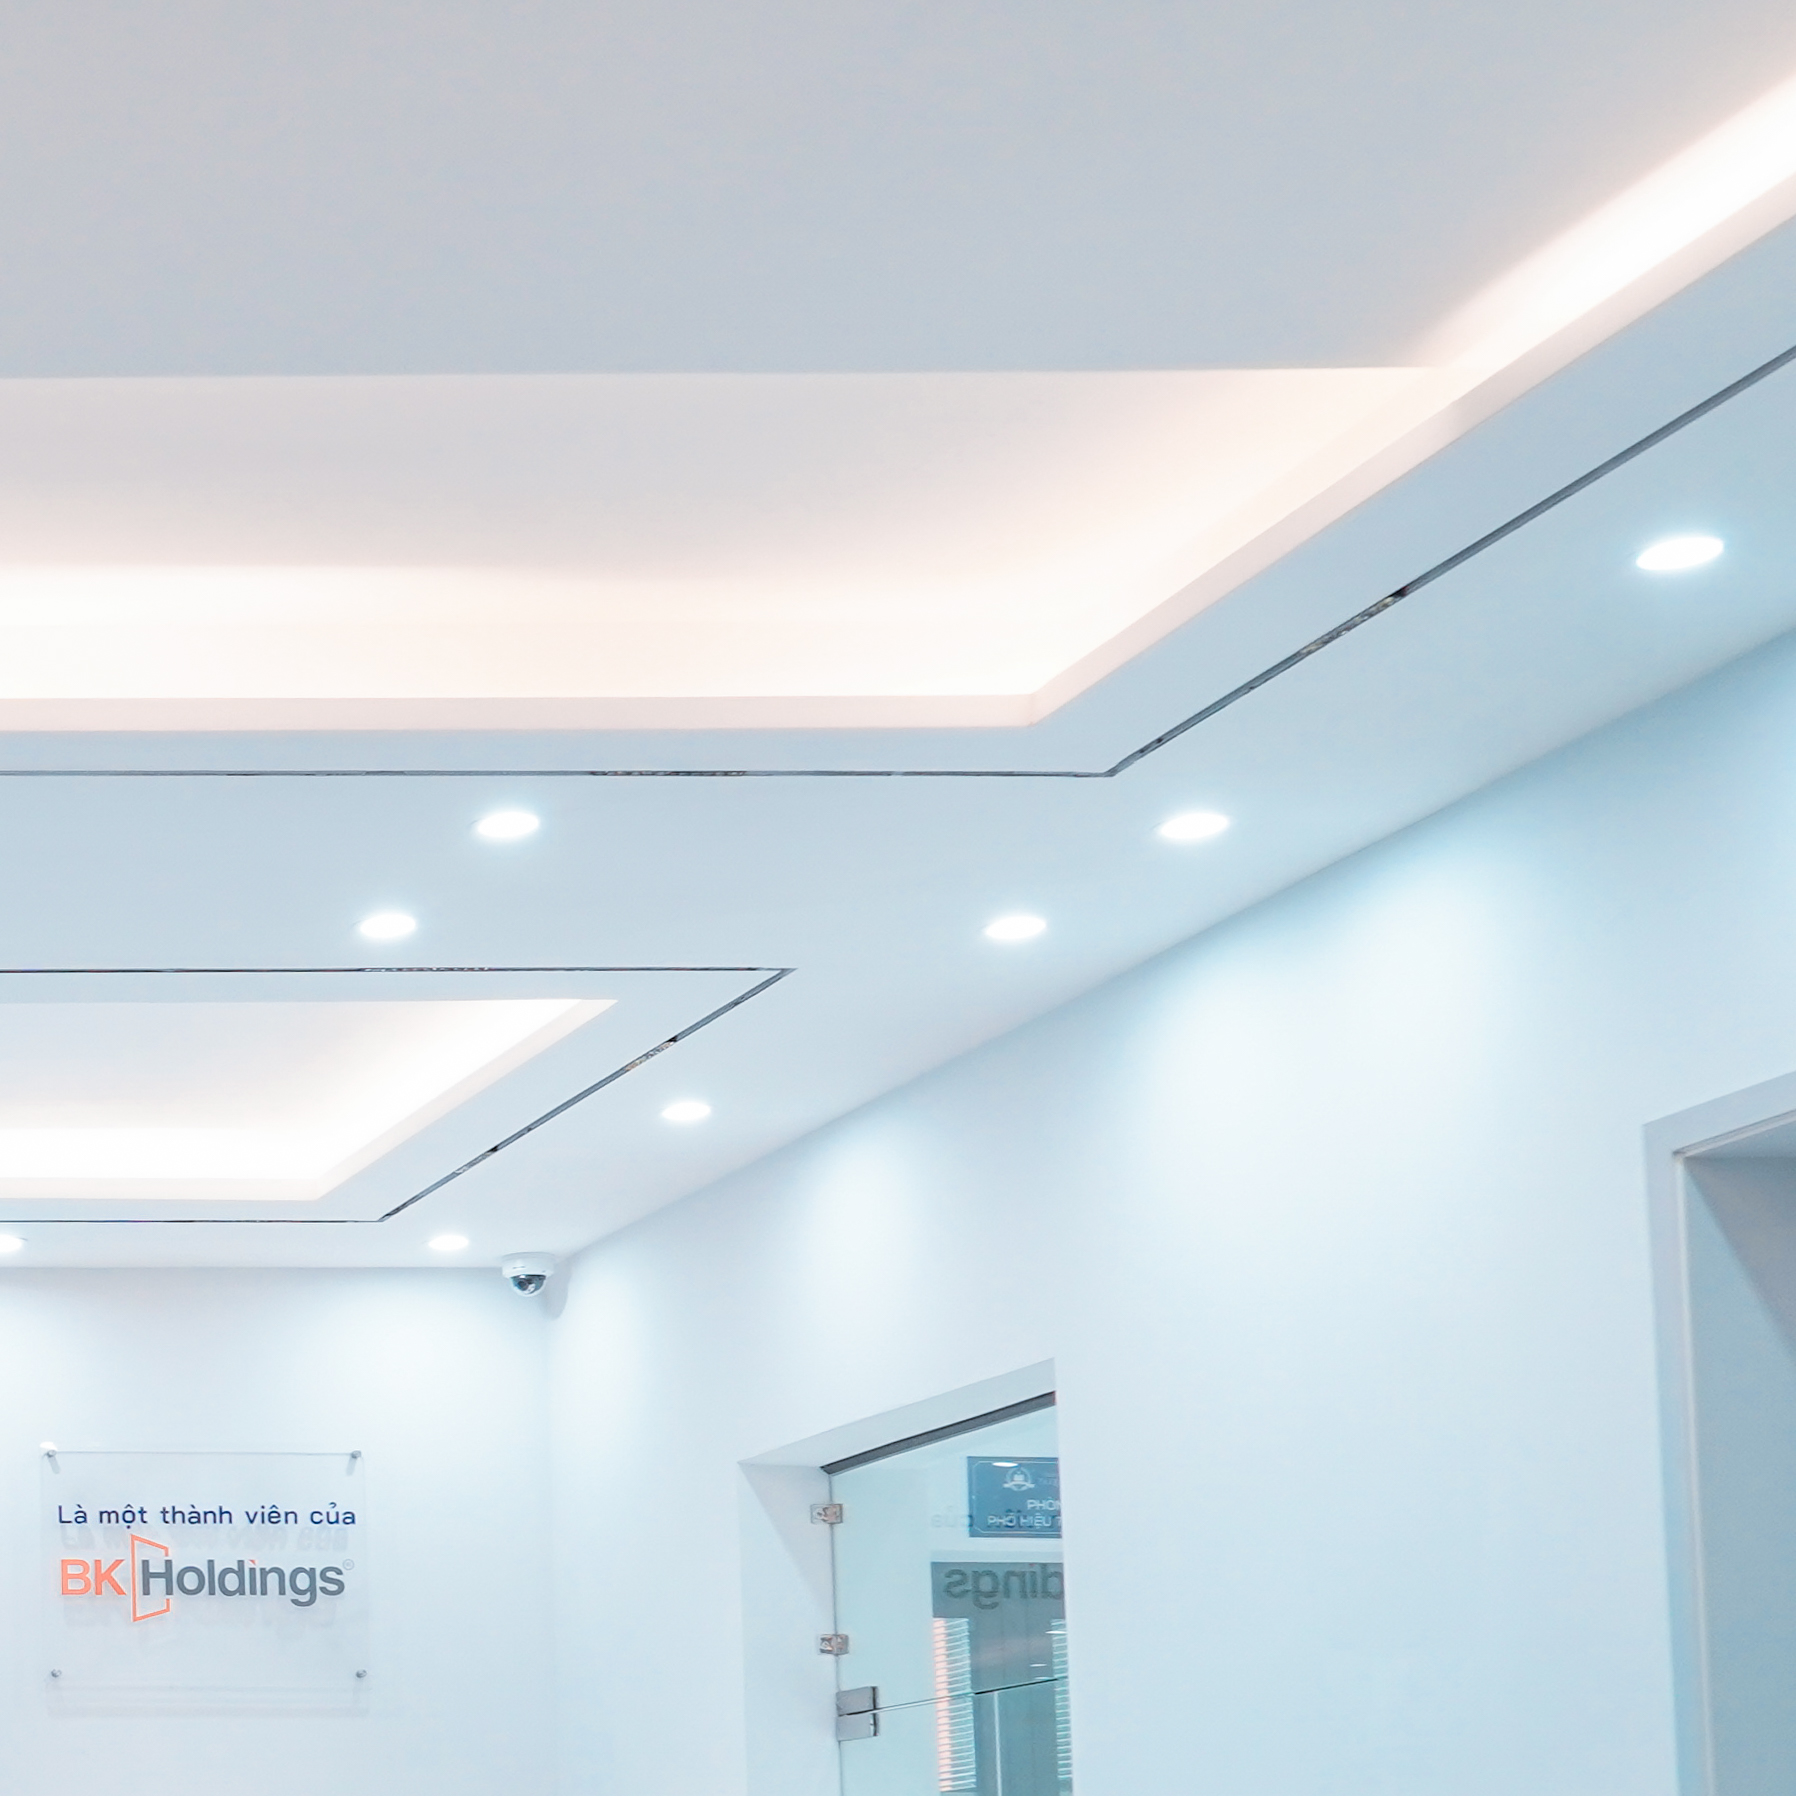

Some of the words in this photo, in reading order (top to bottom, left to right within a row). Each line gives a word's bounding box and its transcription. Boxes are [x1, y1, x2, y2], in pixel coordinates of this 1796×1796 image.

[58, 1504, 88, 1524] Là
[98, 1503, 148, 1530] một
[160, 1504, 233, 1525] thành
[245, 1504, 298, 1525] viên
[309, 1502, 356, 1525] của
[60, 1558, 127, 1596] BK
[141, 1558, 346, 1607] Holdings
